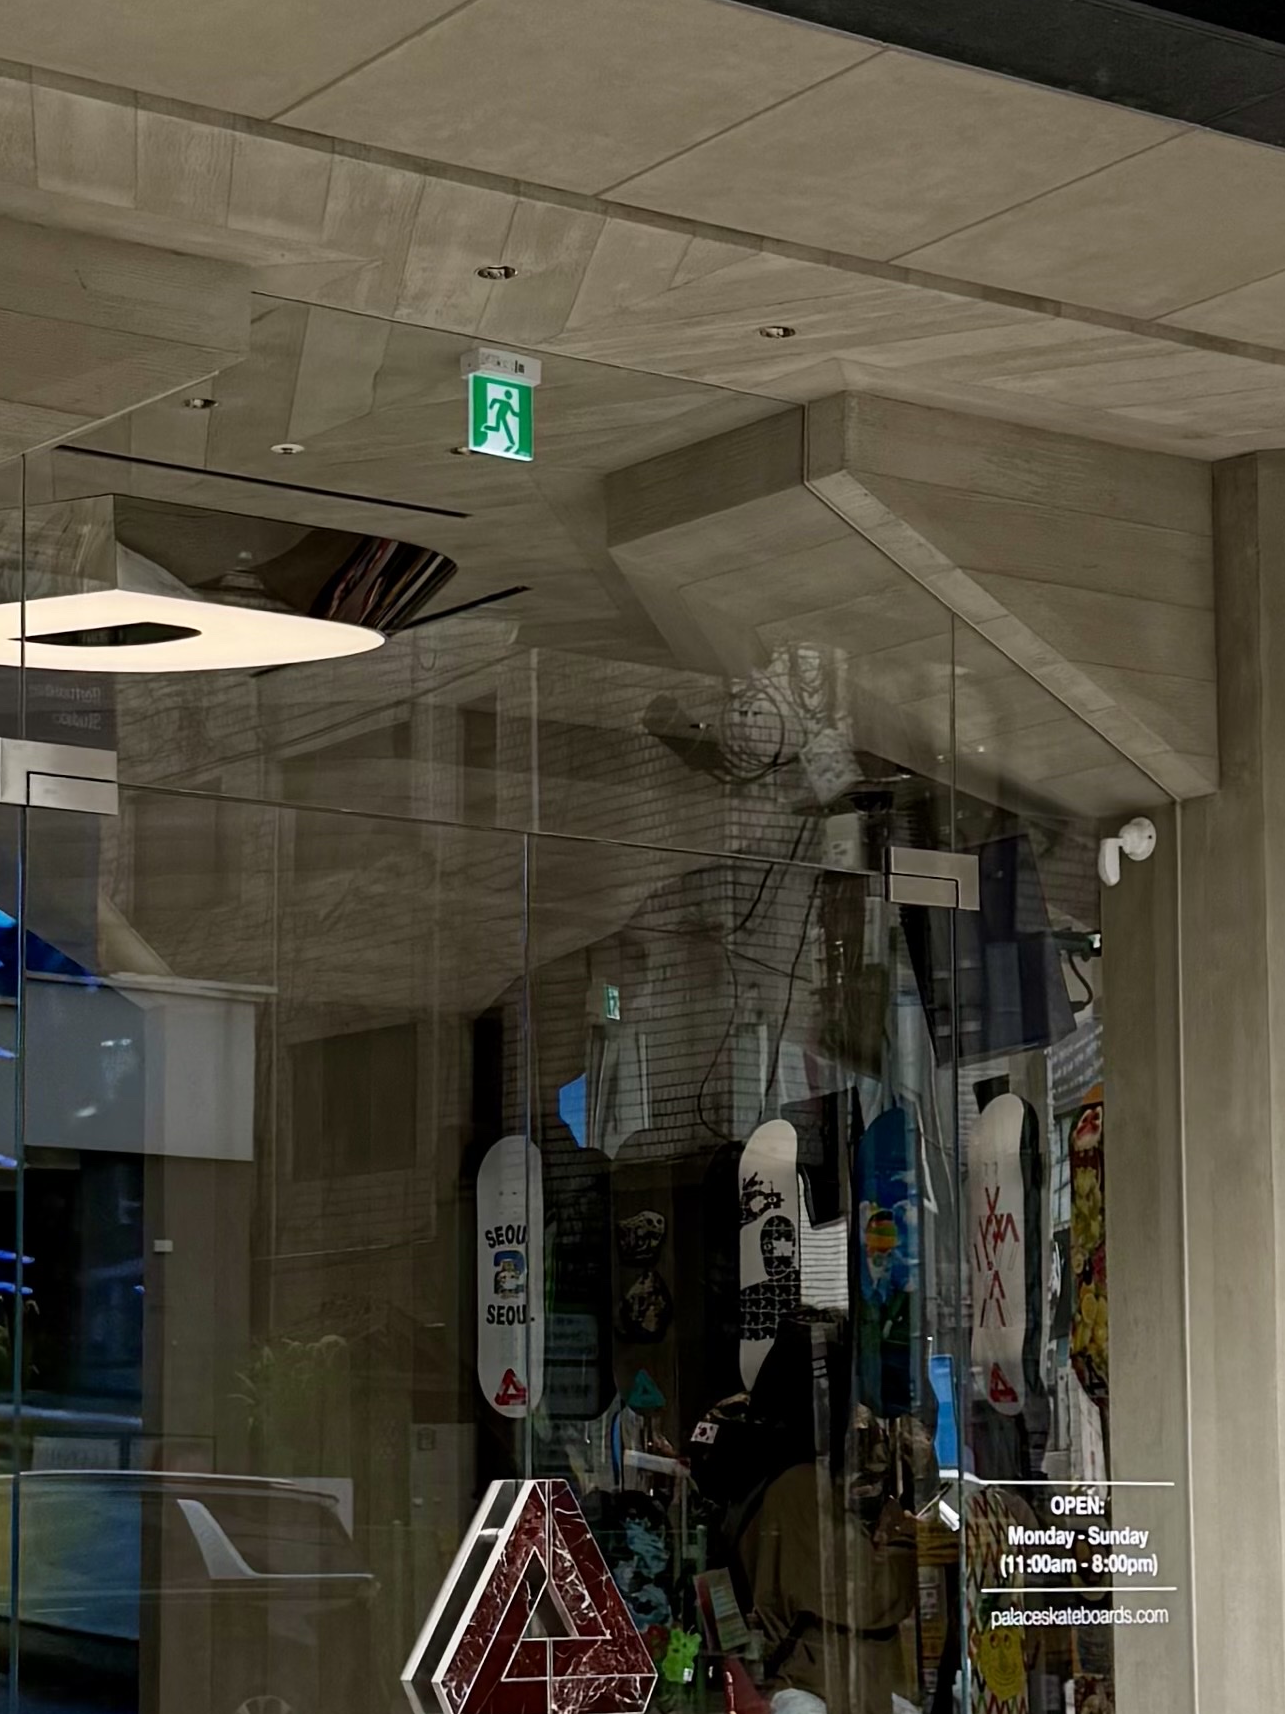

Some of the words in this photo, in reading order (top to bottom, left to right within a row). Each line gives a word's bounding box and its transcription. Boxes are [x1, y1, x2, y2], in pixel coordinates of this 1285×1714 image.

[1050, 1496, 1105, 1515] OPEN:
[1007, 1526, 1075, 1549] Monday
[1087, 1526, 1149, 1550] Sunday
[999, 1554, 1077, 1577] (11:00am
[1091, 1553, 1158, 1577] 8:00pm)
[991, 1606, 1170, 1629] palaceskateboards.com
